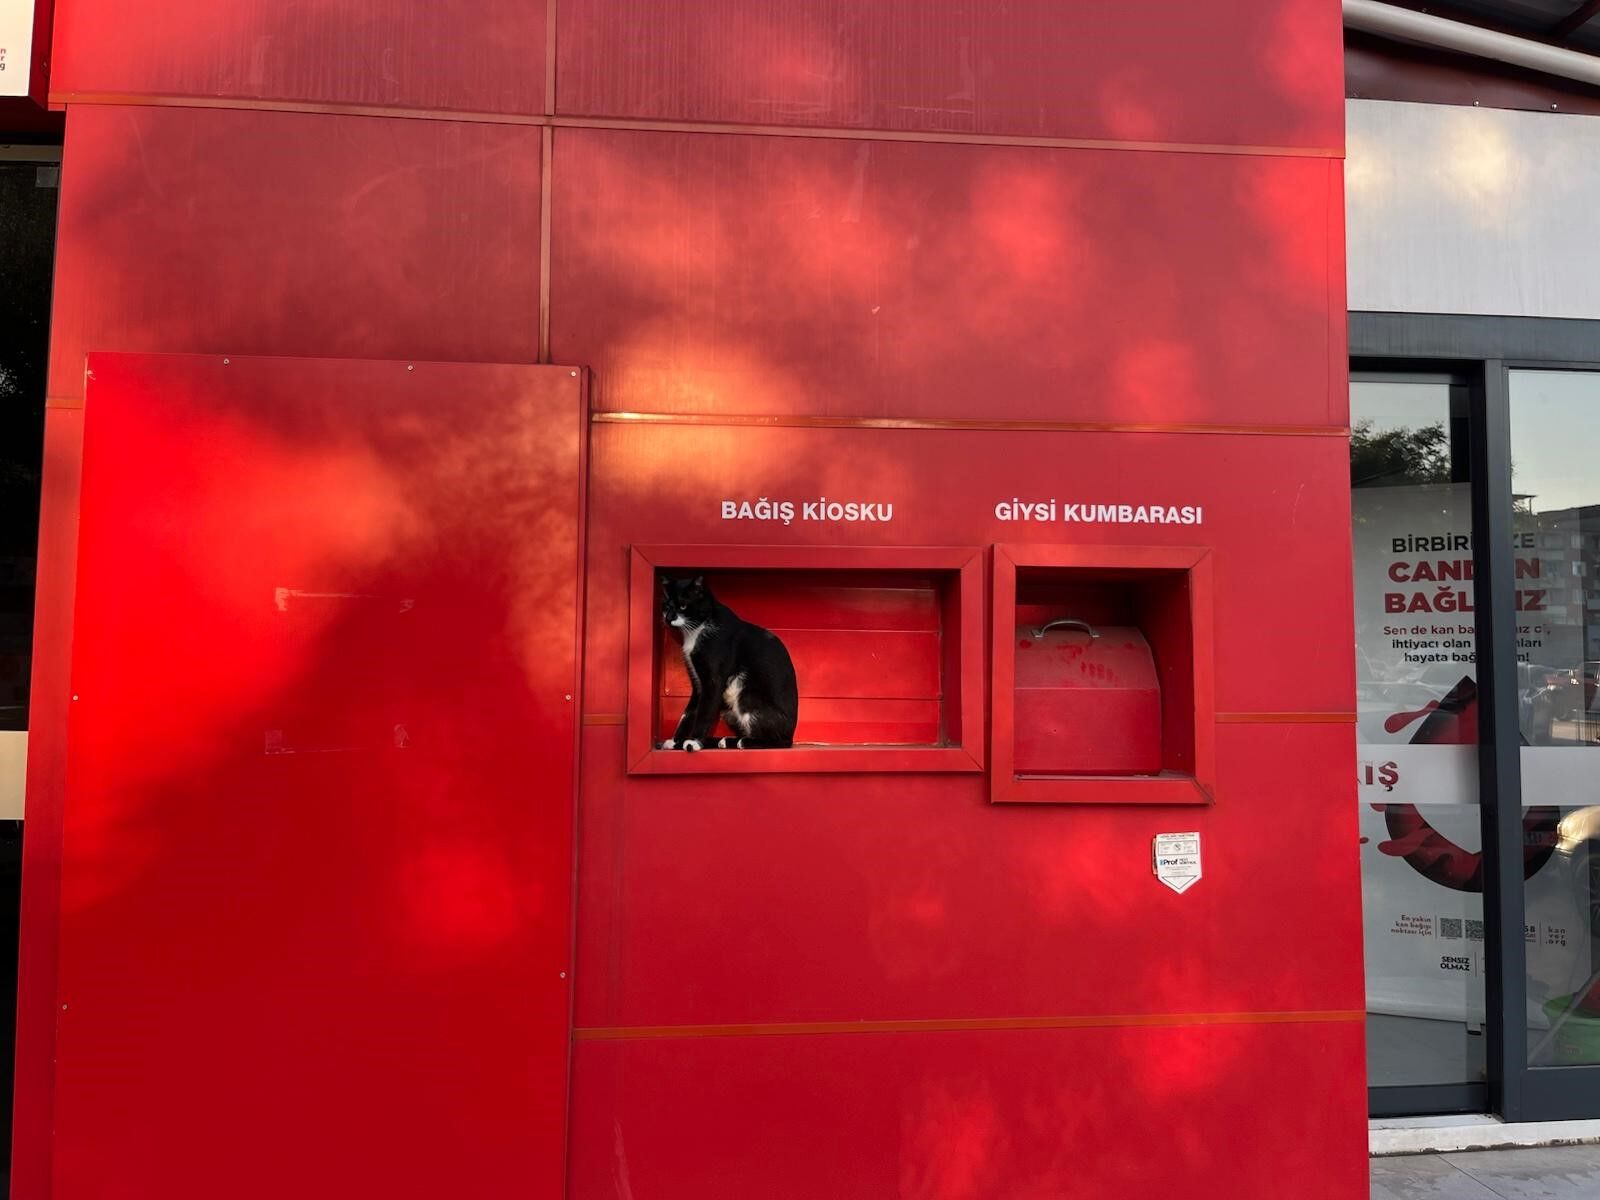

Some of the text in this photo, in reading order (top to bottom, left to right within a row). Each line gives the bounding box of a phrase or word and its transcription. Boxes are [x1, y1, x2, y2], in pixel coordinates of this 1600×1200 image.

[721, 497, 893, 525] BAĞIŞ KİOSKU
[994, 498, 1202, 525] GİYSİ KUMBARASI
[1384, 626, 1406, 635] Sen
[1410, 625, 1427, 634] de
[1431, 625, 1454, 634] kan
[1392, 639, 1438, 650] ihtiyacı
[1443, 638, 1471, 648] olan
[1404, 652, 1448, 664] hayata
